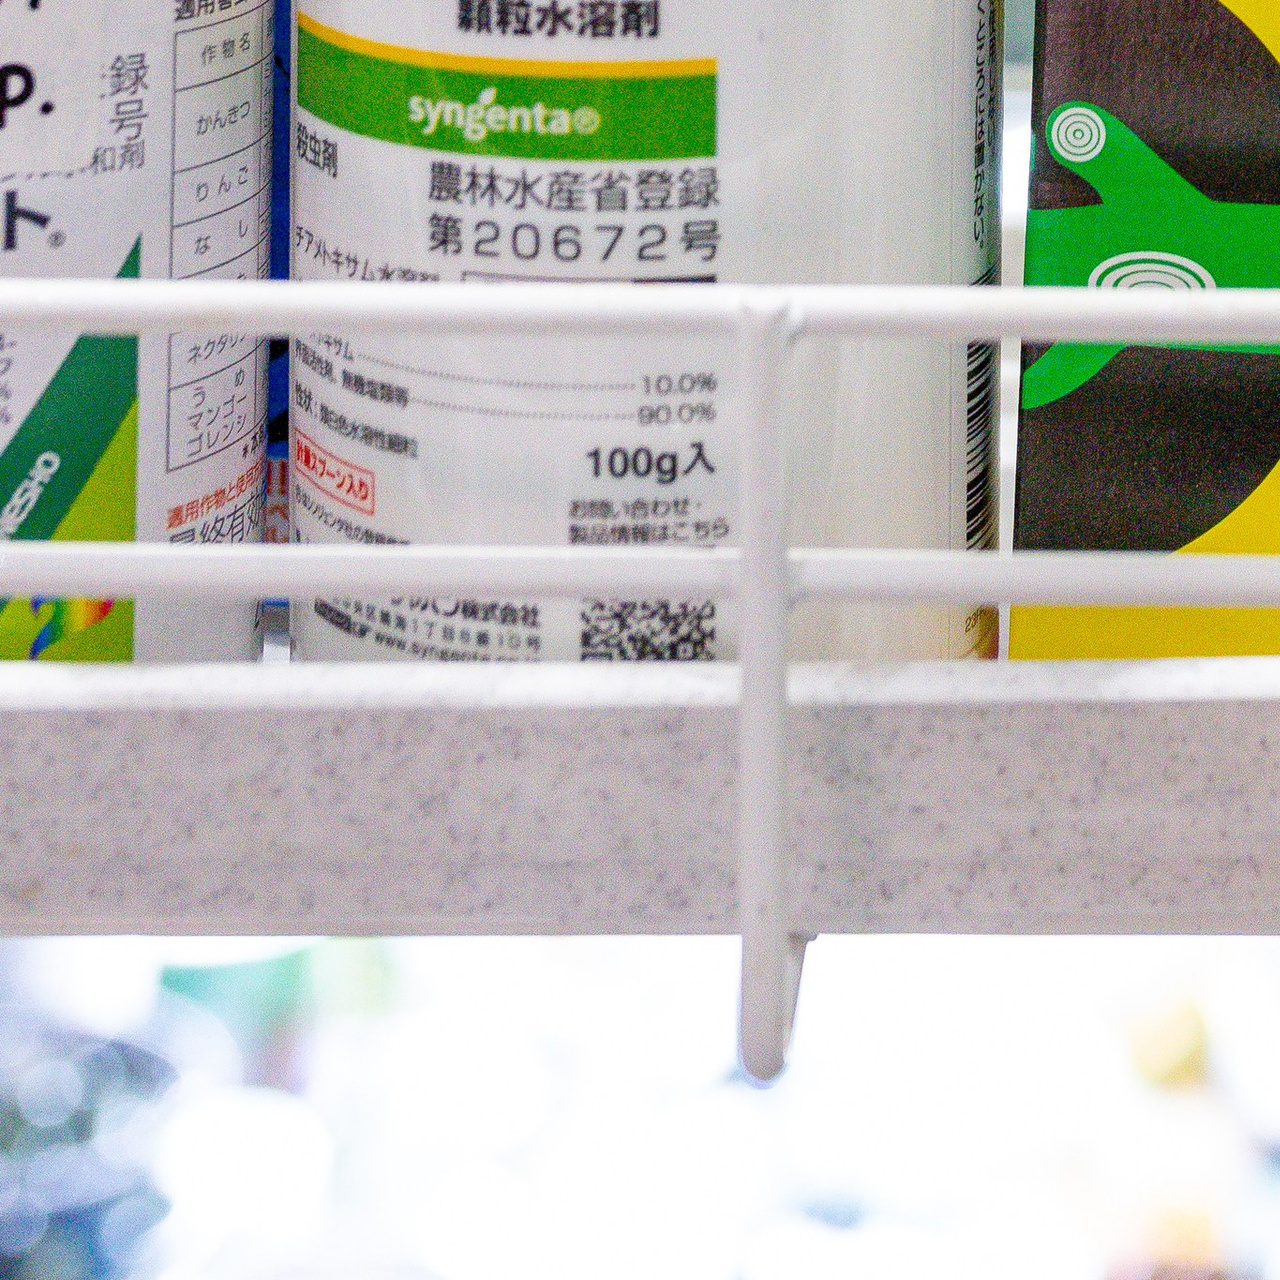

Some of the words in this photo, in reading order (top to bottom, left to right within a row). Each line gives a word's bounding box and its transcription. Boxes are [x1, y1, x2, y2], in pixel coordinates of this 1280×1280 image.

[407, 87, 573, 143] syngenta
[428, 160, 721, 212] 農林水産省登録
[428, 212, 722, 263] 第20672号
[586, 441, 716, 485] 100g入
